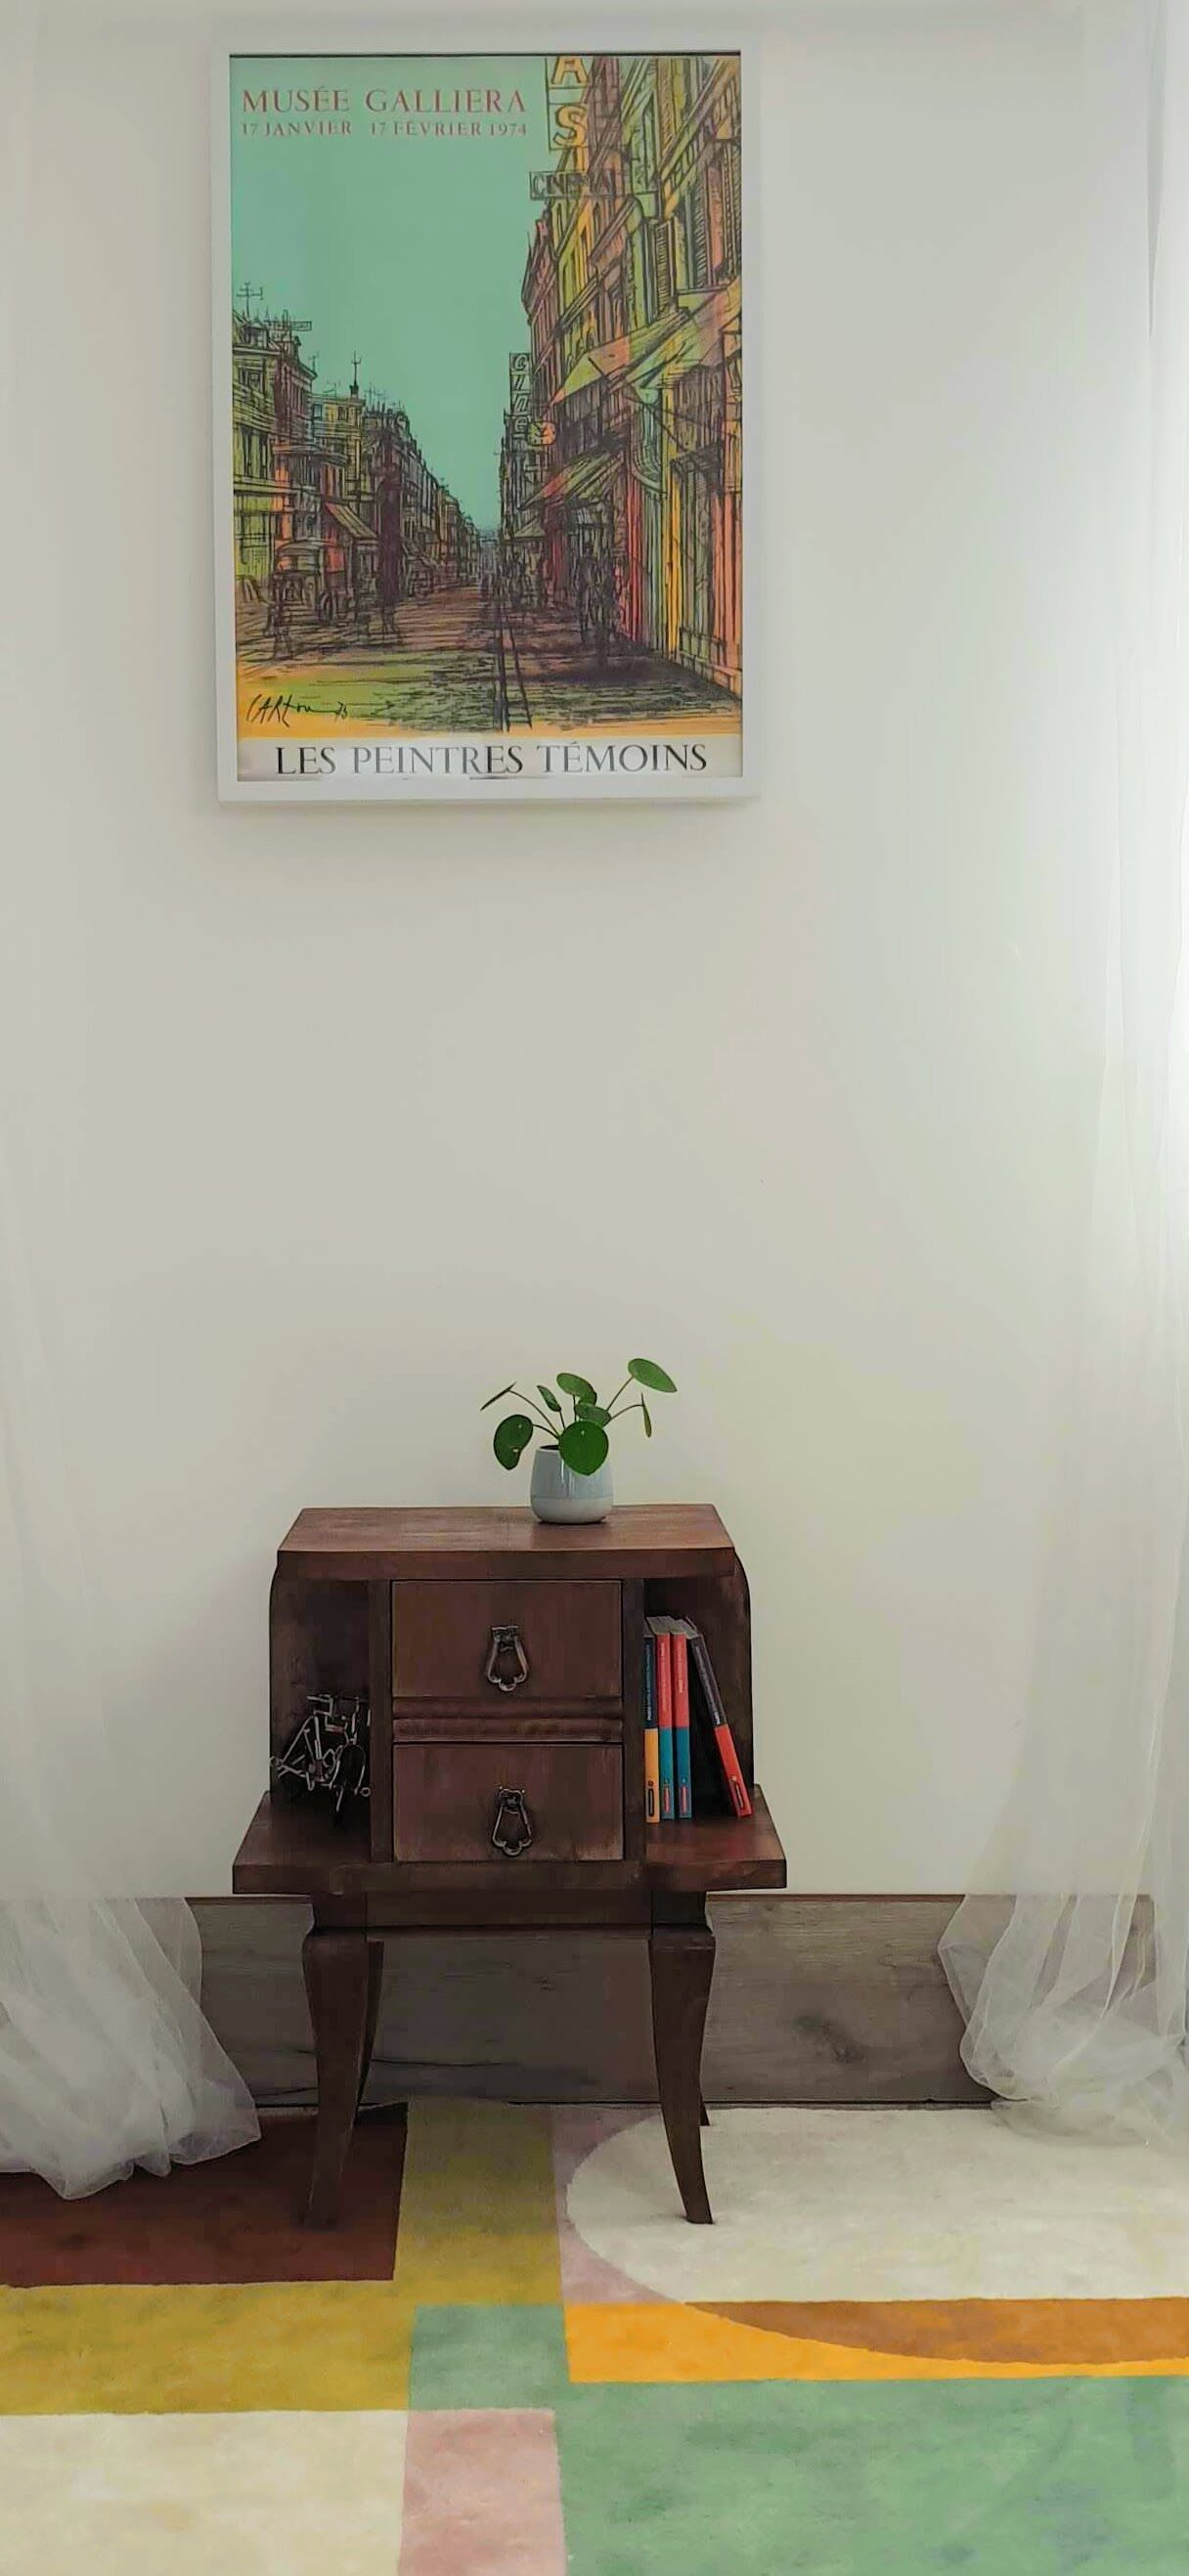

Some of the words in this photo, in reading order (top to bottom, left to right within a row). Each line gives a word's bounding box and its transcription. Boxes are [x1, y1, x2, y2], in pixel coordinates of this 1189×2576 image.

[242, 86, 350, 113] MUSÉE
[365, 88, 526, 113] GALLIERA
[242, 122, 258, 136] 17
[265, 120, 352, 137] JANVIER
[371, 122, 387, 136] 17
[488, 121, 527, 137] 1974
[275, 746, 336, 775] LES
[352, 744, 523, 775] PEINTRES
[537, 740, 707, 774] TÉMOINS
